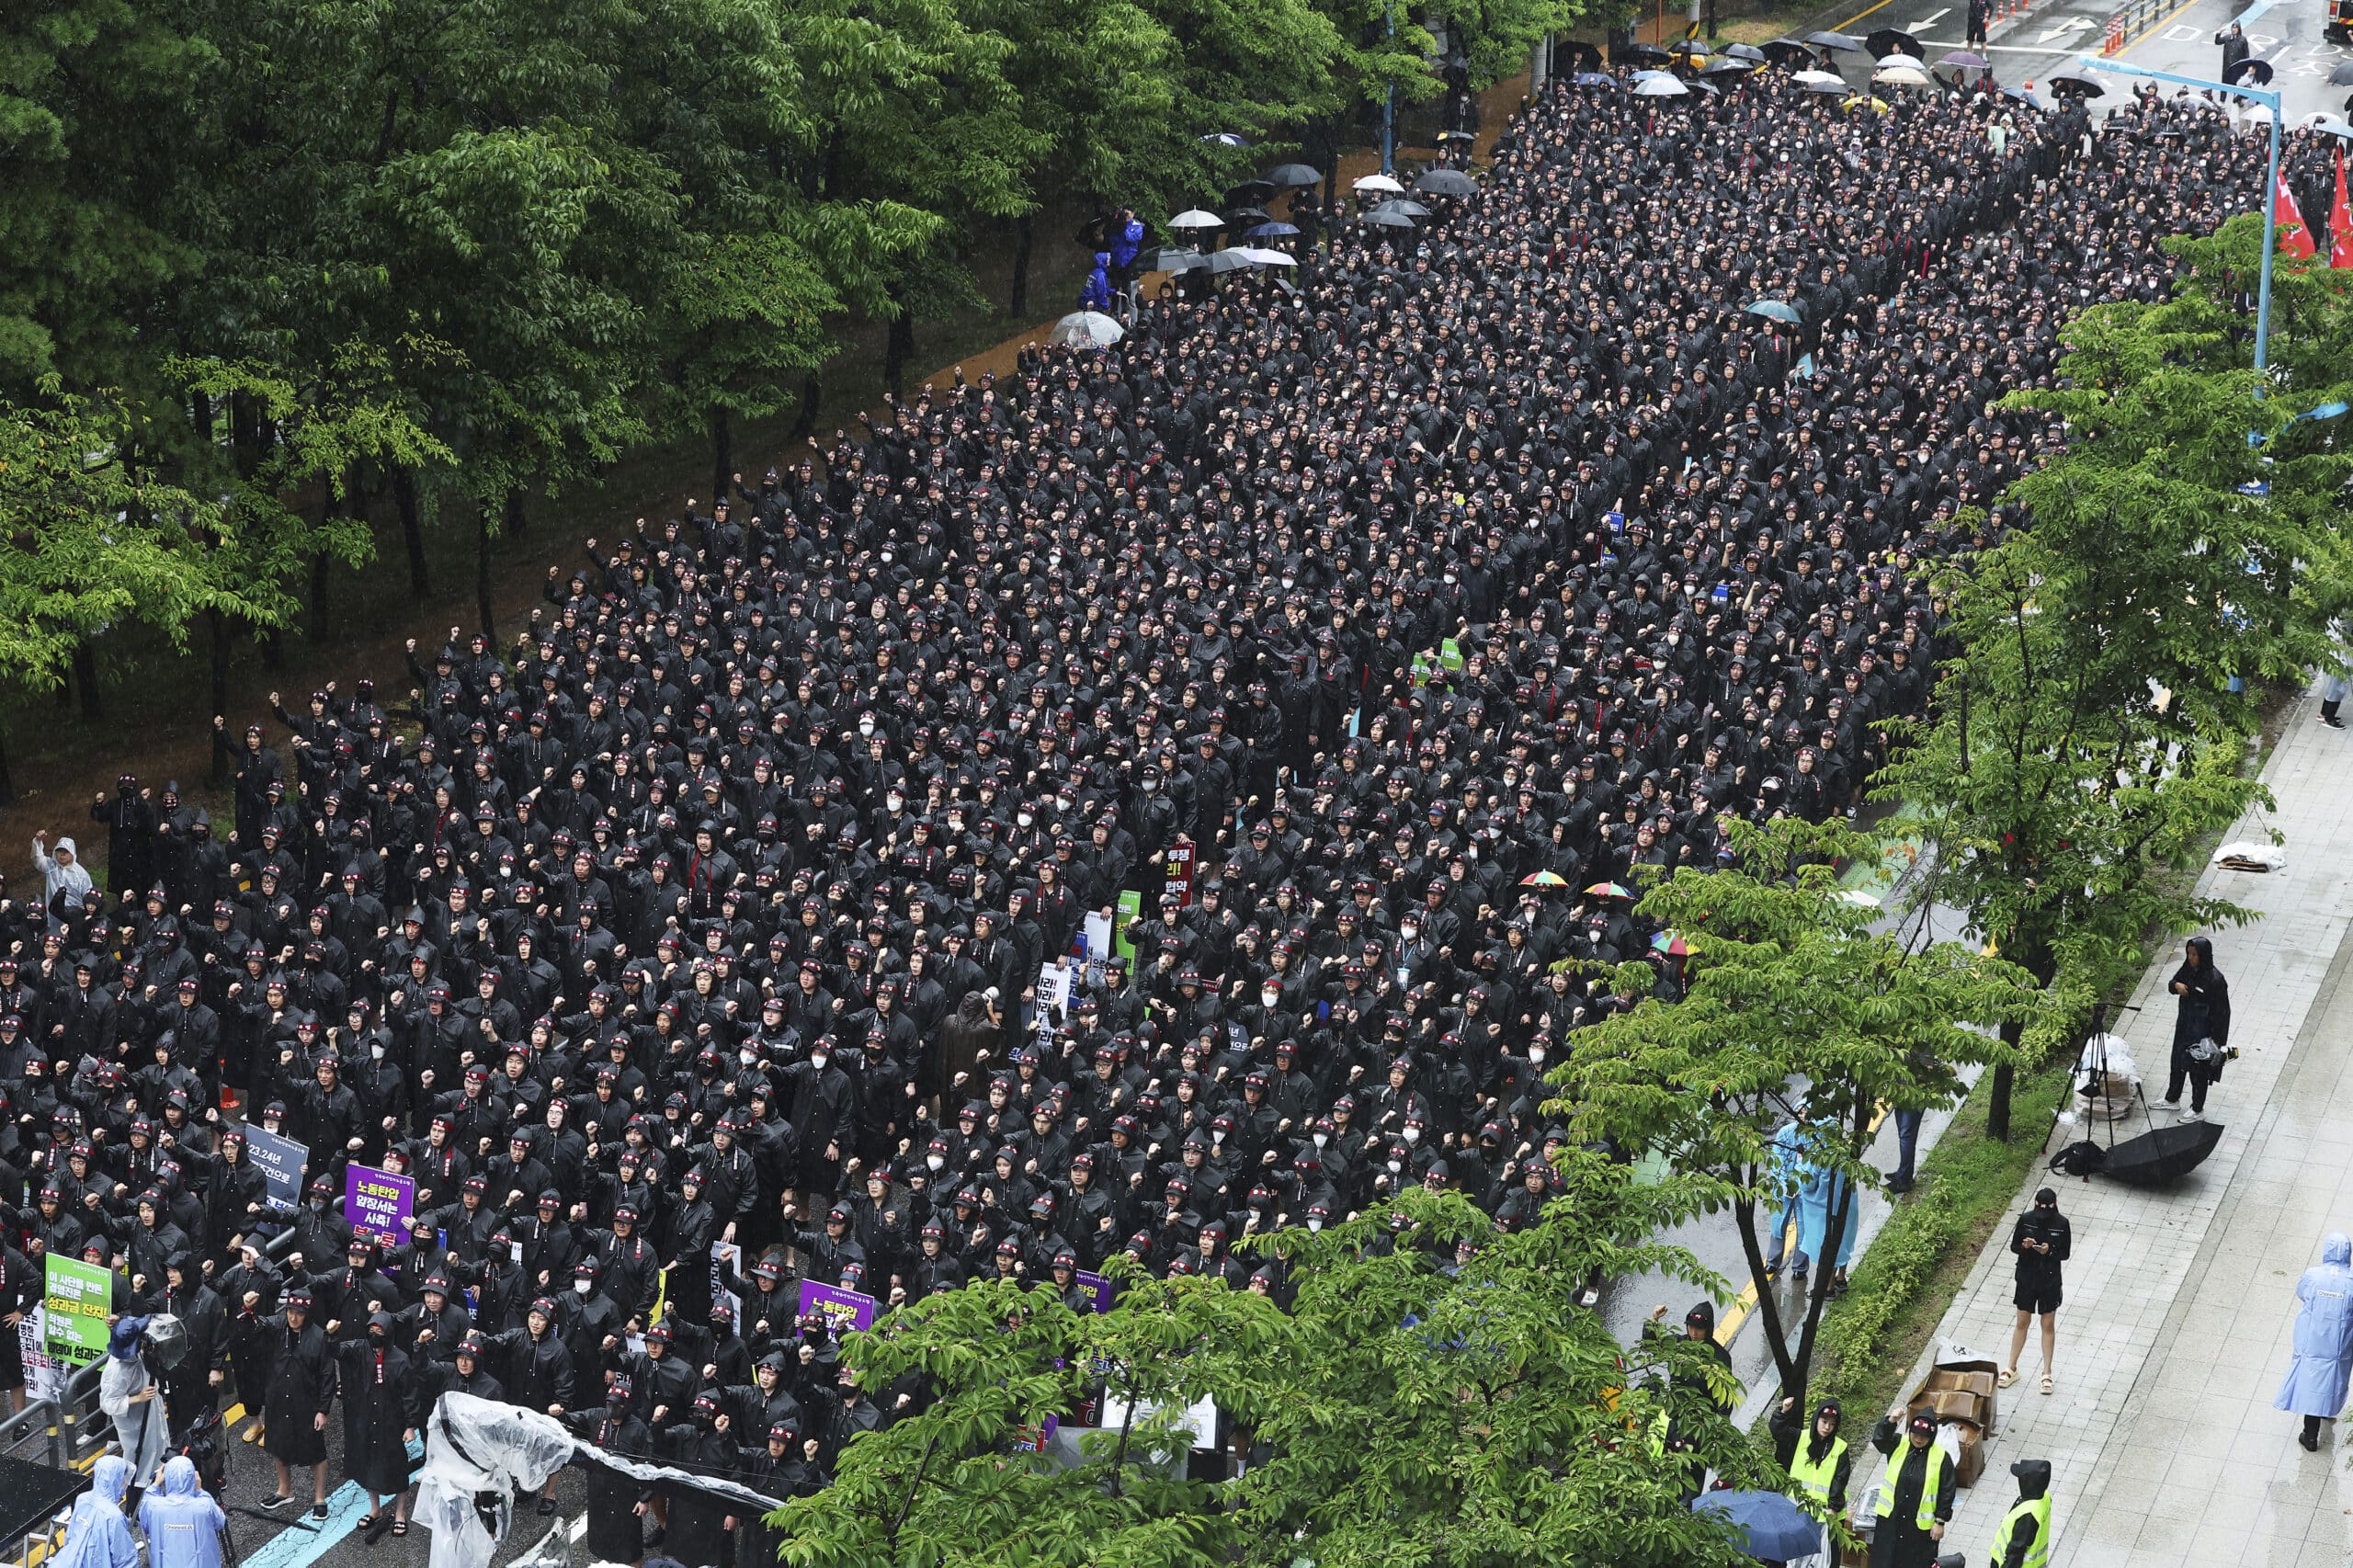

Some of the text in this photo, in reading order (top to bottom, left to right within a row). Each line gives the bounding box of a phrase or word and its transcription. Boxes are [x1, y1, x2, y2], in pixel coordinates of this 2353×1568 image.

[1166, 862, 1182, 876] 리!
[356, 1180, 400, 1201] 노동탄압
[356, 1195, 398, 1215] 앞장서는
